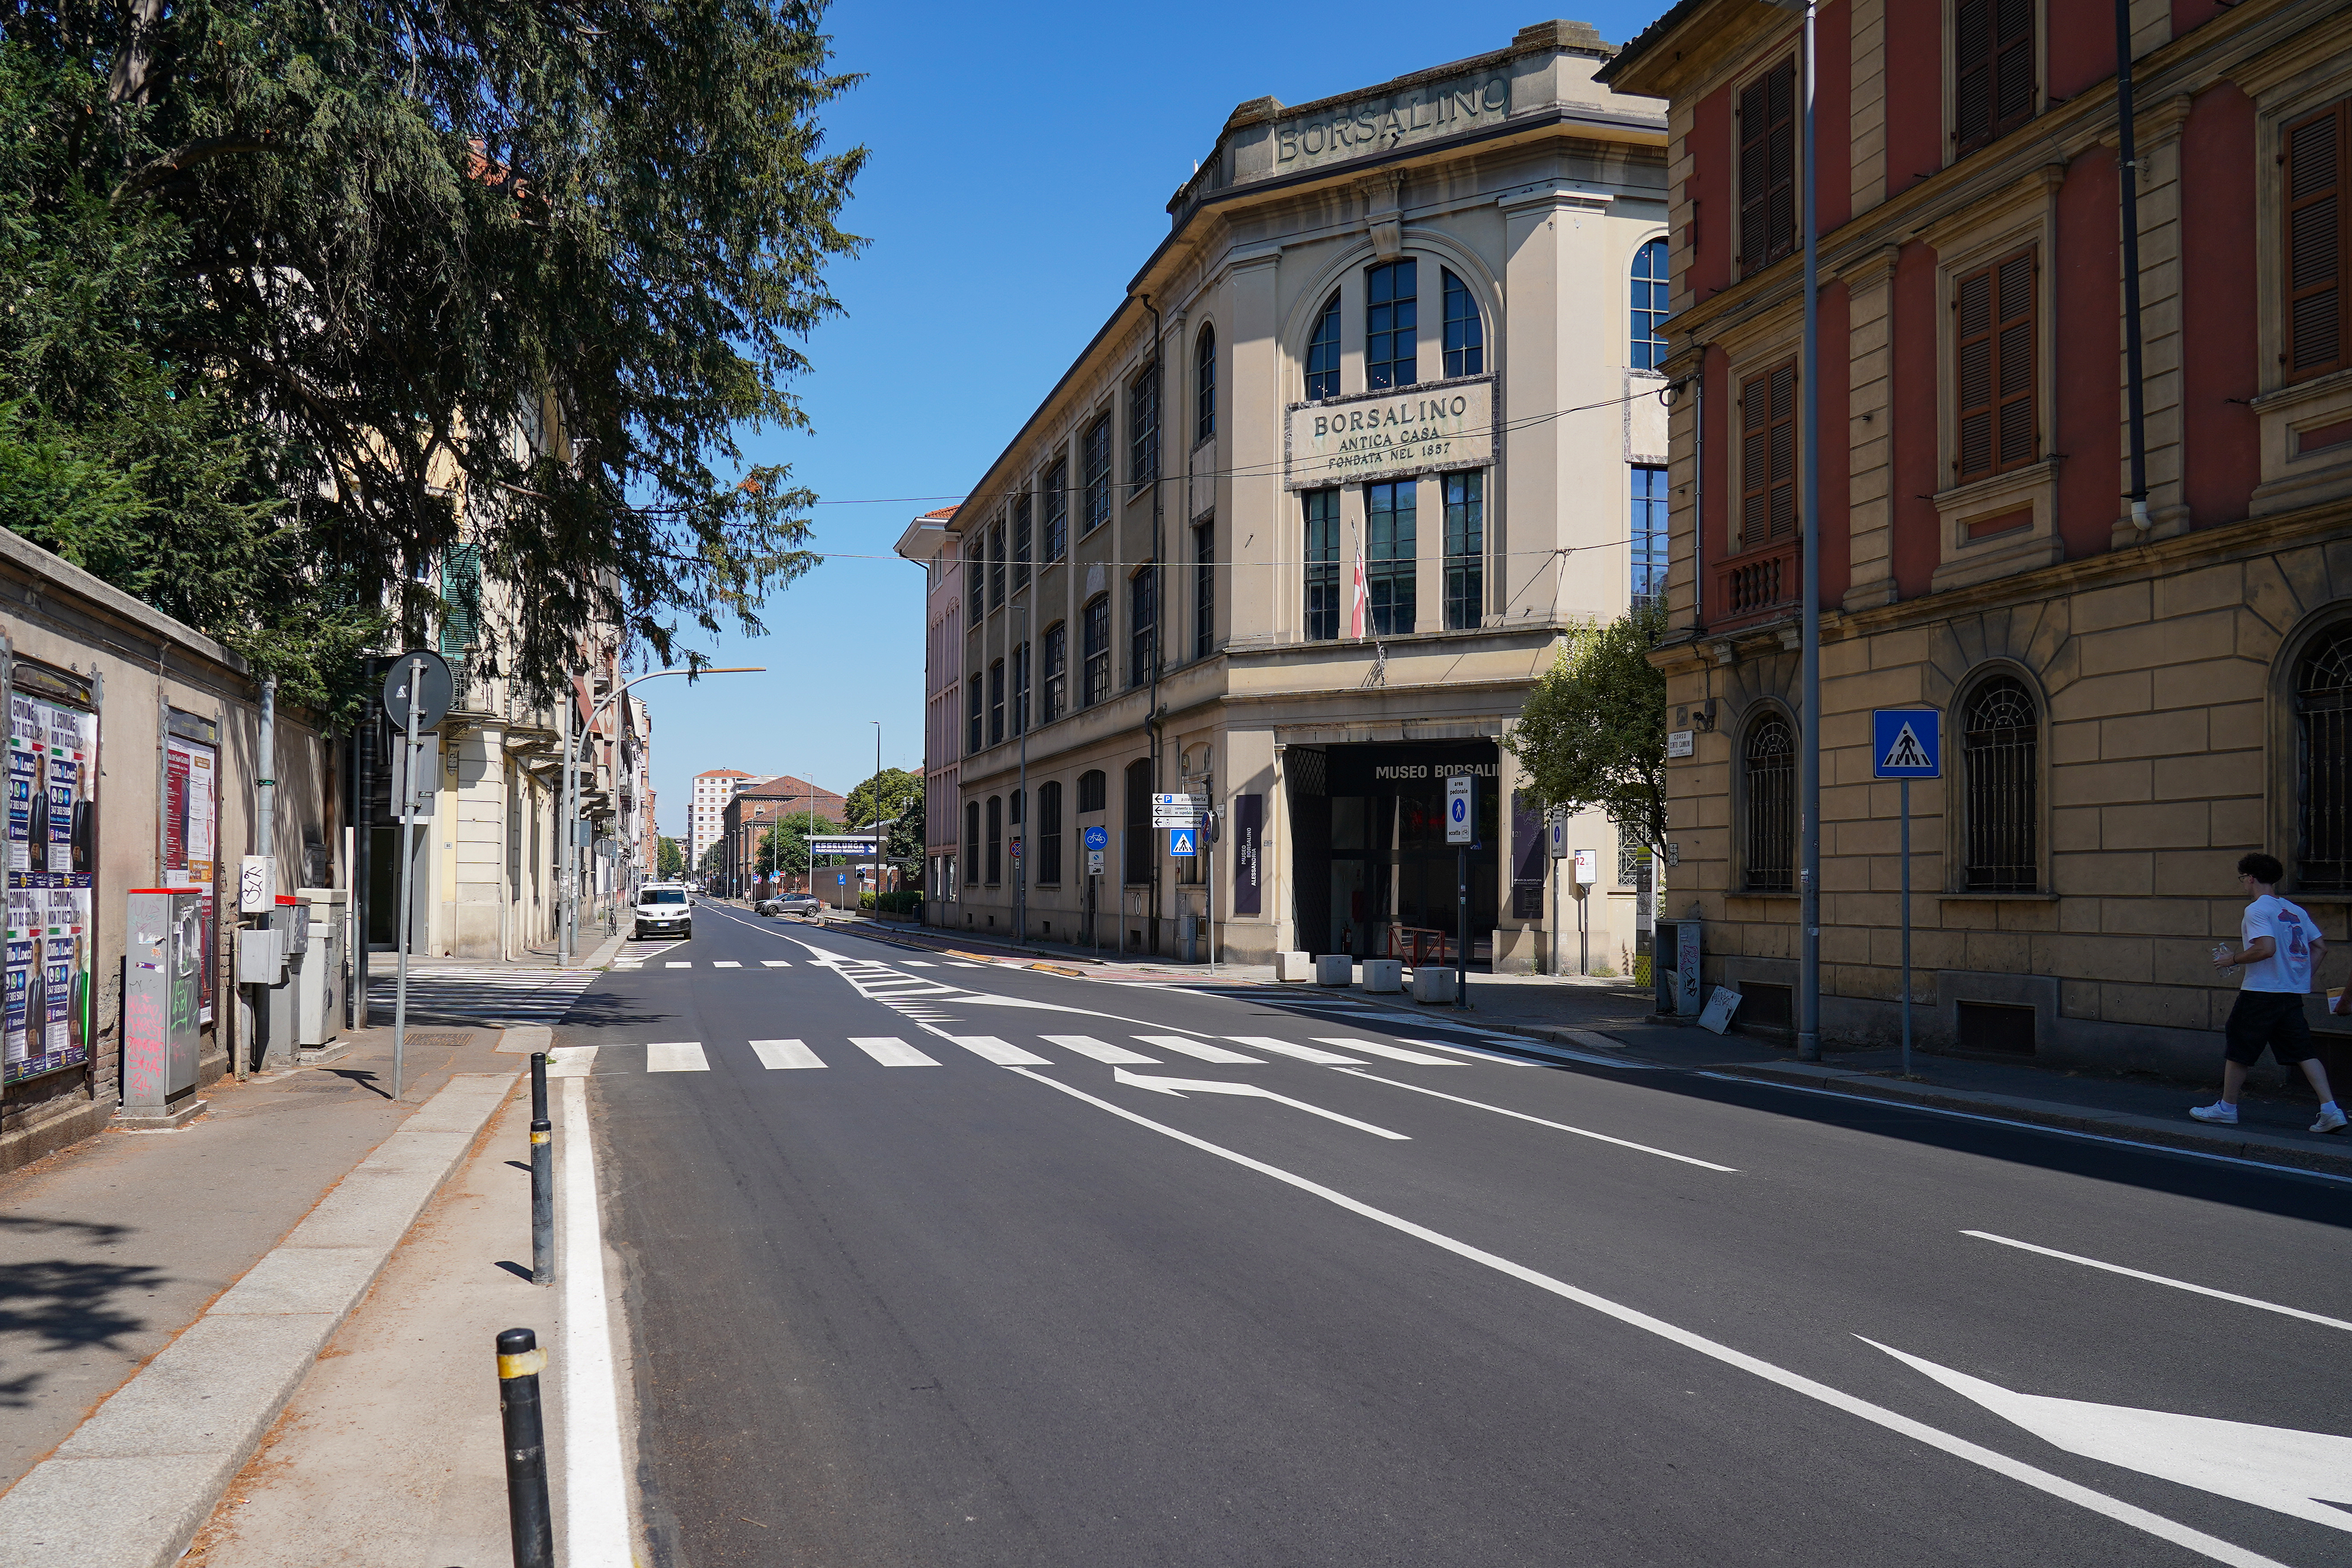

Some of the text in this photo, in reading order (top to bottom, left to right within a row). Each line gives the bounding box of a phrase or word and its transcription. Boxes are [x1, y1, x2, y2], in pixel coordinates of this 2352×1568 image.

[1278, 78, 1509, 163] BORSALINO
[1314, 396, 1466, 437] BORSALINO
[1339, 426, 1439, 452] ANTICA CASA
[1328, 442, 1451, 470] FONDATA NEL 1857
[13, 699, 34, 721] COMUNE
[17, 721, 20, 737] TI
[22, 724, 43, 741] ASCOLTA?
[57, 712, 75, 732] COMUNE
[60, 732, 64, 747] TI
[65, 733, 83, 751] ASCOLTA?
[1376, 764, 1500, 779] MUSEO BORSALI
[1575, 857, 1584, 865] 12
[48, 891, 52, 907] IL
[14, 912, 17, 927] TI
[48, 910, 56, 925] NON
[58, 910, 61, 924] TI
[48, 942, 74, 957] DilloALocci
